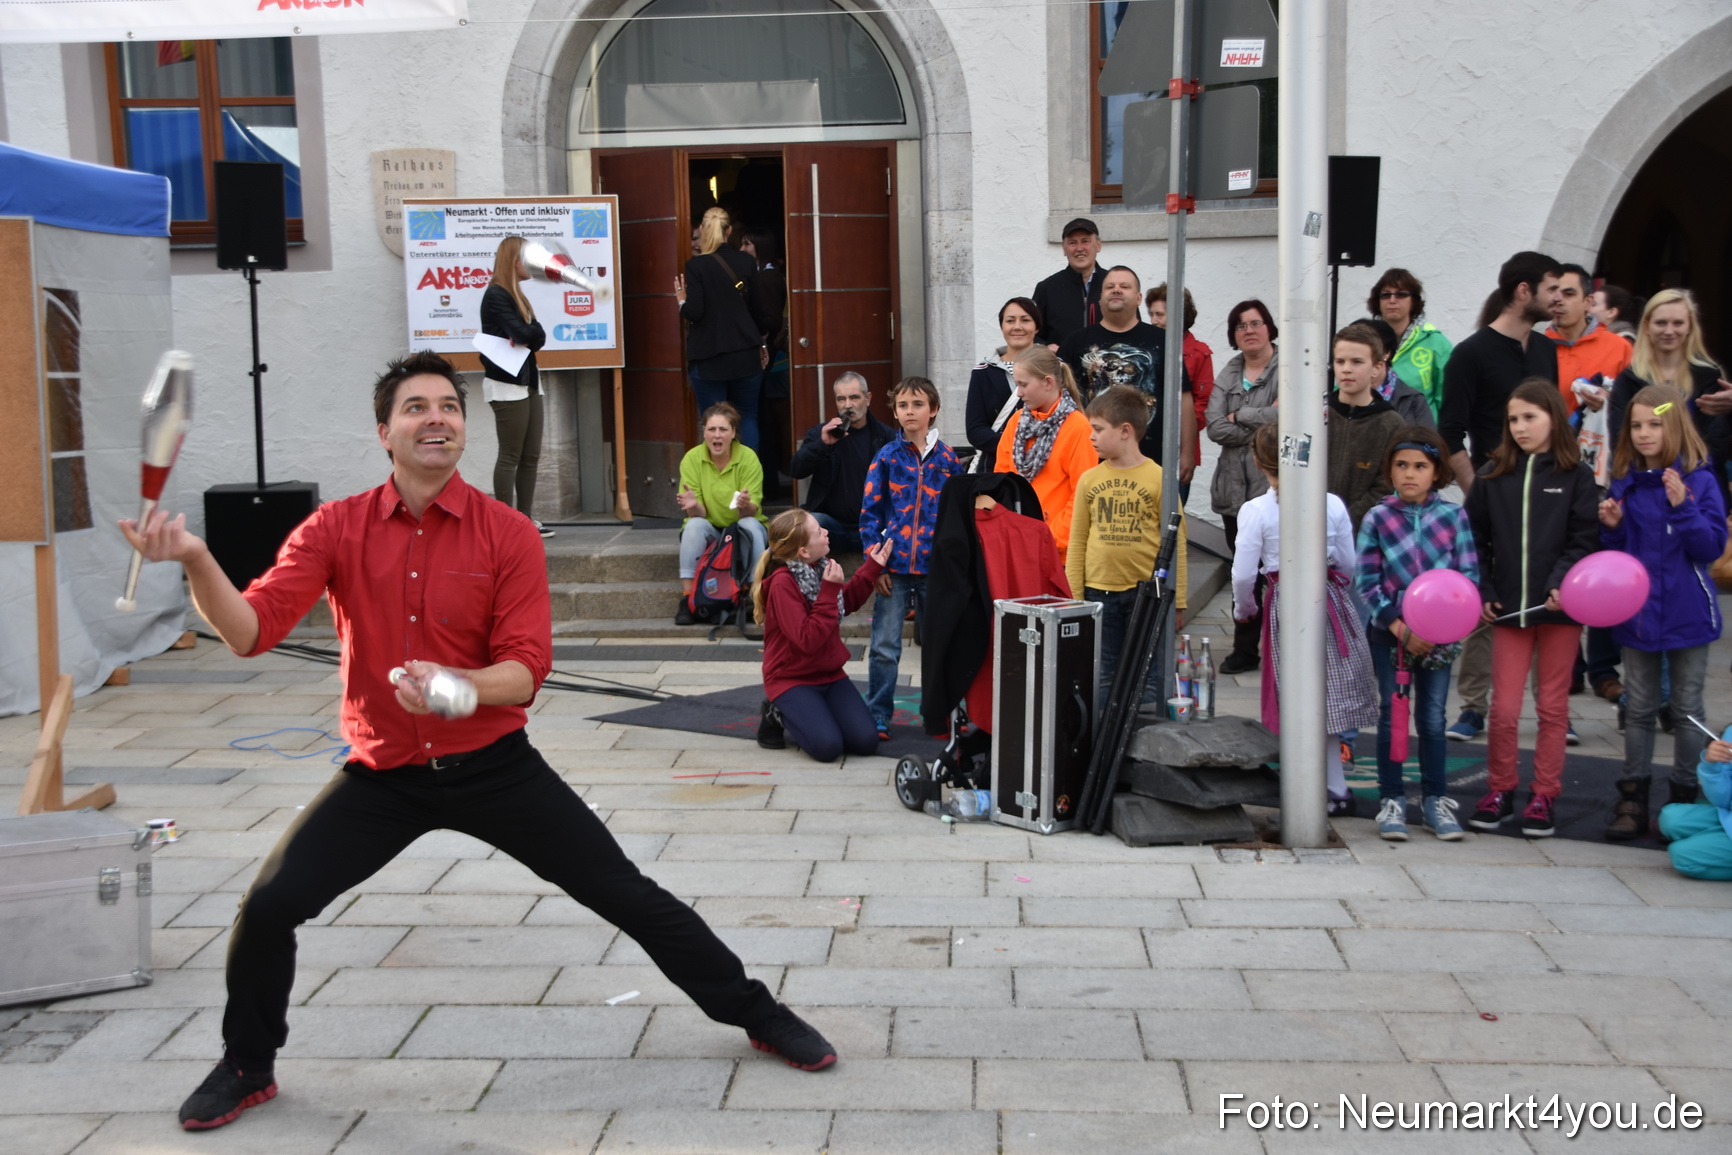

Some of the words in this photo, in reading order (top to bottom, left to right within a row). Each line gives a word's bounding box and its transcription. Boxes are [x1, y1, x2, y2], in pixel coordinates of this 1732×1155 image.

[1222, 53, 1260, 65] HAHN
[383, 160, 444, 172] Rathaus
[445, 207, 487, 216] Neumarkt
[495, 207, 518, 216] Offen
[520, 207, 536, 216] und
[538, 206, 570, 215] inklusiv
[1086, 479, 1138, 504] SUBURBAN
[1098, 497, 1140, 523] Night
